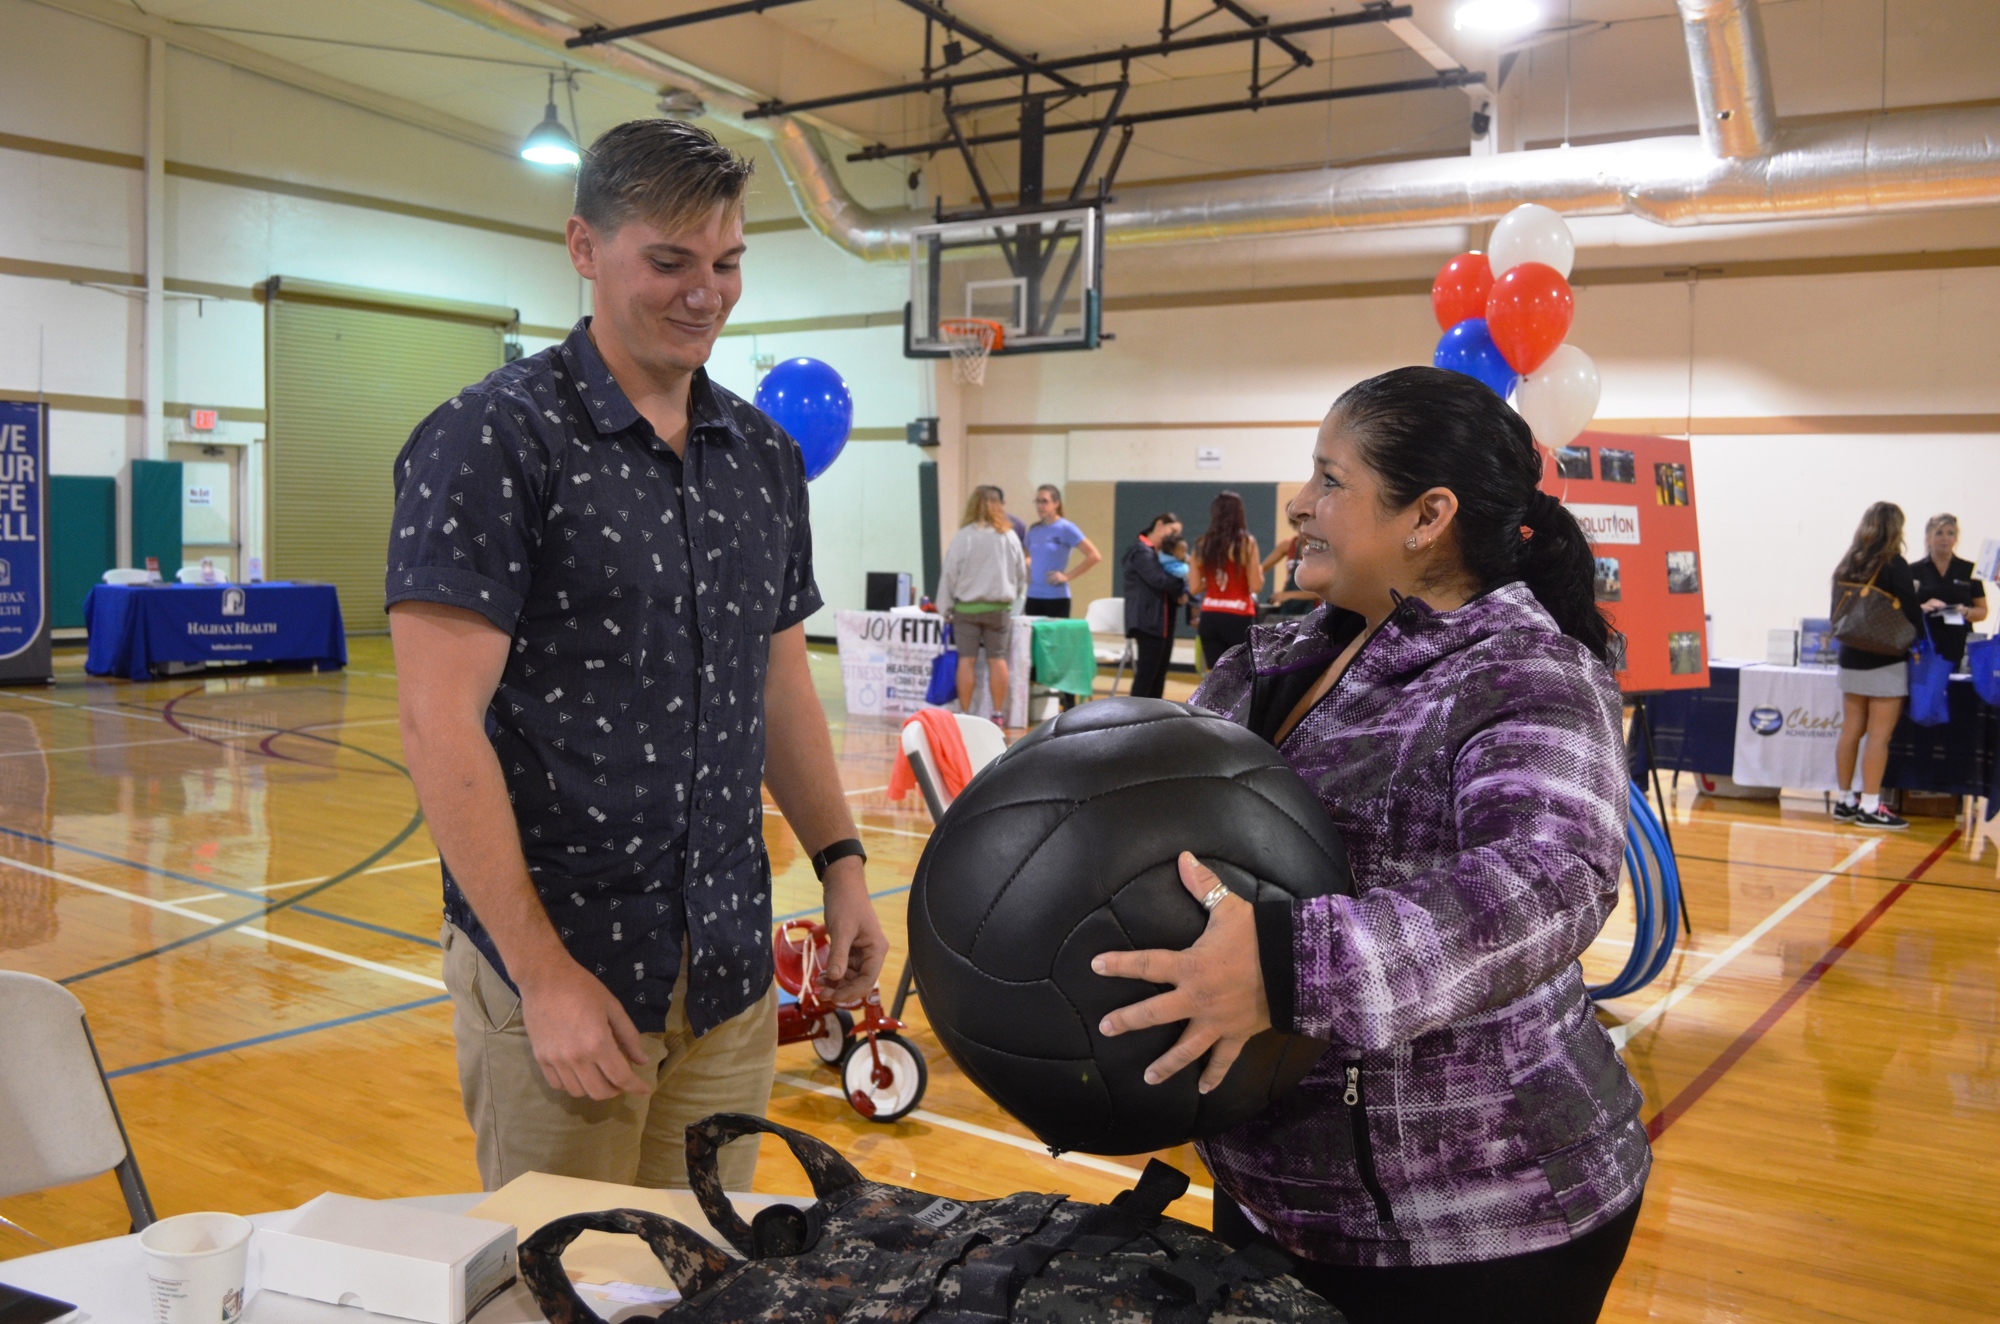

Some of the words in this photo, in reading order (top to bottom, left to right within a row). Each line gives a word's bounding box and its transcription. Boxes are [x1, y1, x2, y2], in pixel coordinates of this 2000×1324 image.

[195, 410, 216, 429] EXIT
[187, 622, 233, 634] HALIFAX
[235, 621, 278, 635] HEALTH
[860, 617, 900, 641] JOY
